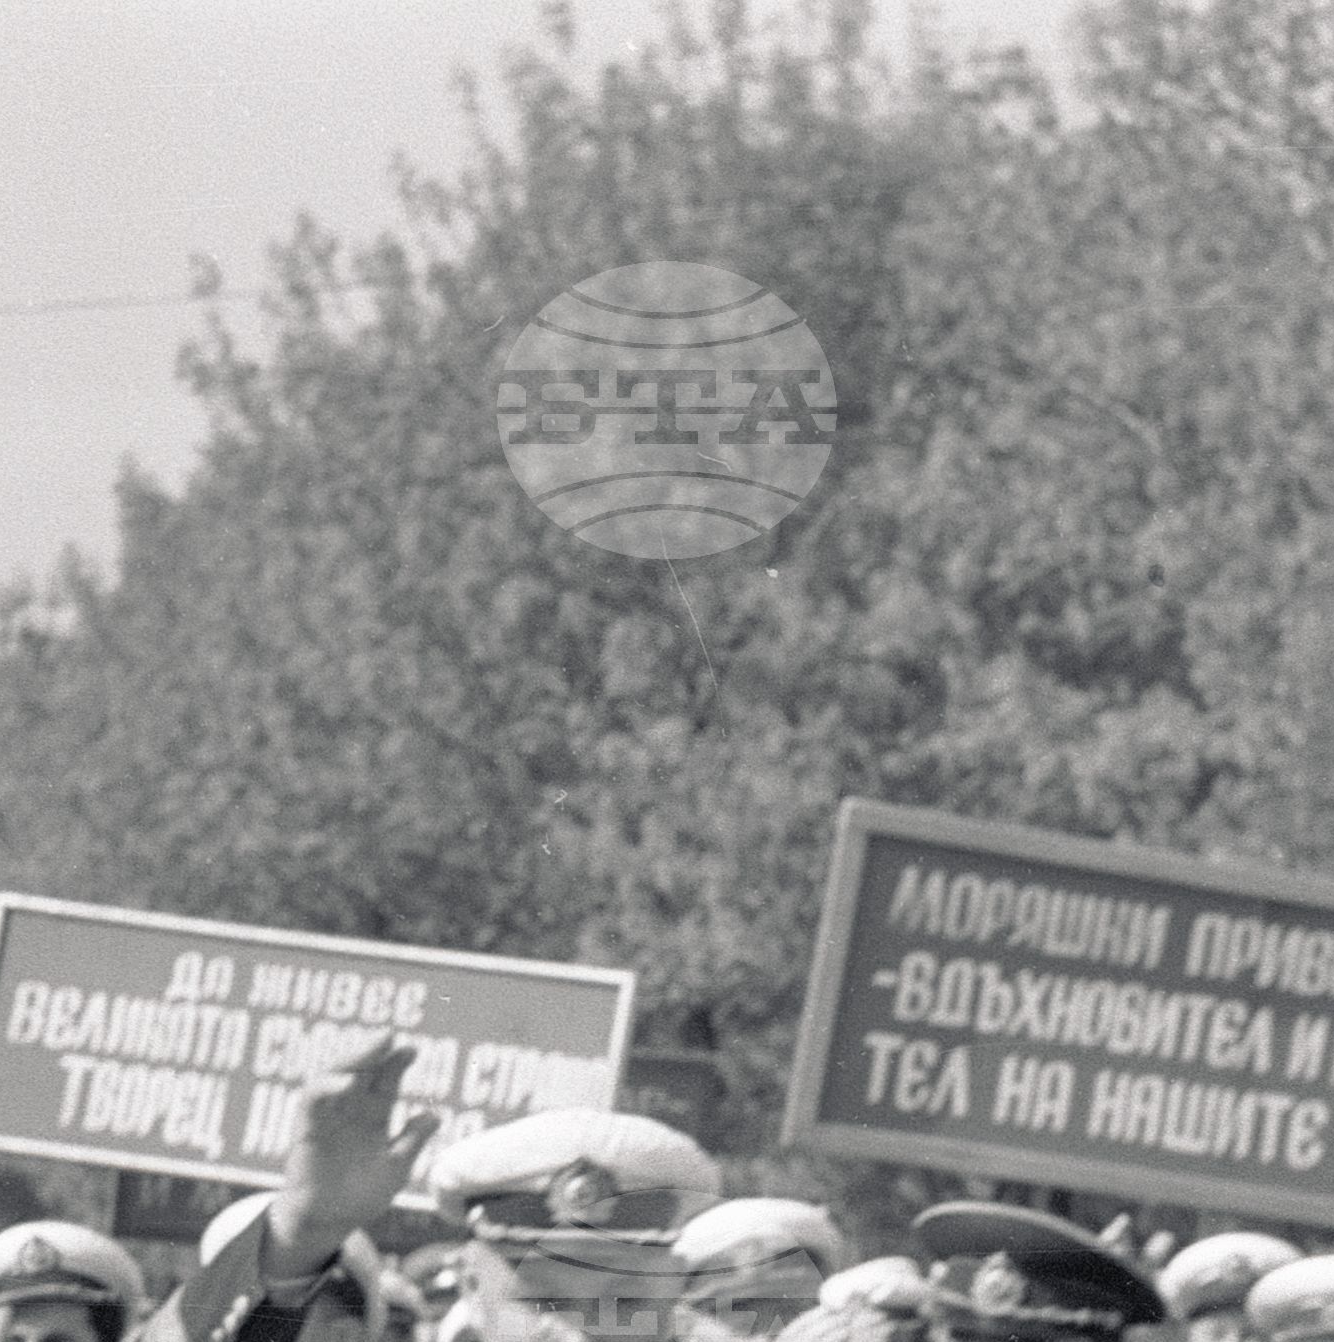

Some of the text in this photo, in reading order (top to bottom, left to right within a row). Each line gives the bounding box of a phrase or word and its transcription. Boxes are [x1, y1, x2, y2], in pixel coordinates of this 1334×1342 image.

[885, 863, 1171, 971] МОРЯШКИ
[165, 951, 427, 1029] ДА ЖИВЕЕ
[1286, 1012, 1330, 1083] И
[58, 1054, 230, 1160] ТВОРЕЦ
[865, 1030, 969, 1119] ТЕЛ
[992, 1053, 1075, 1135] НА
[1085, 1067, 1330, 1173] НАШИТЕ
